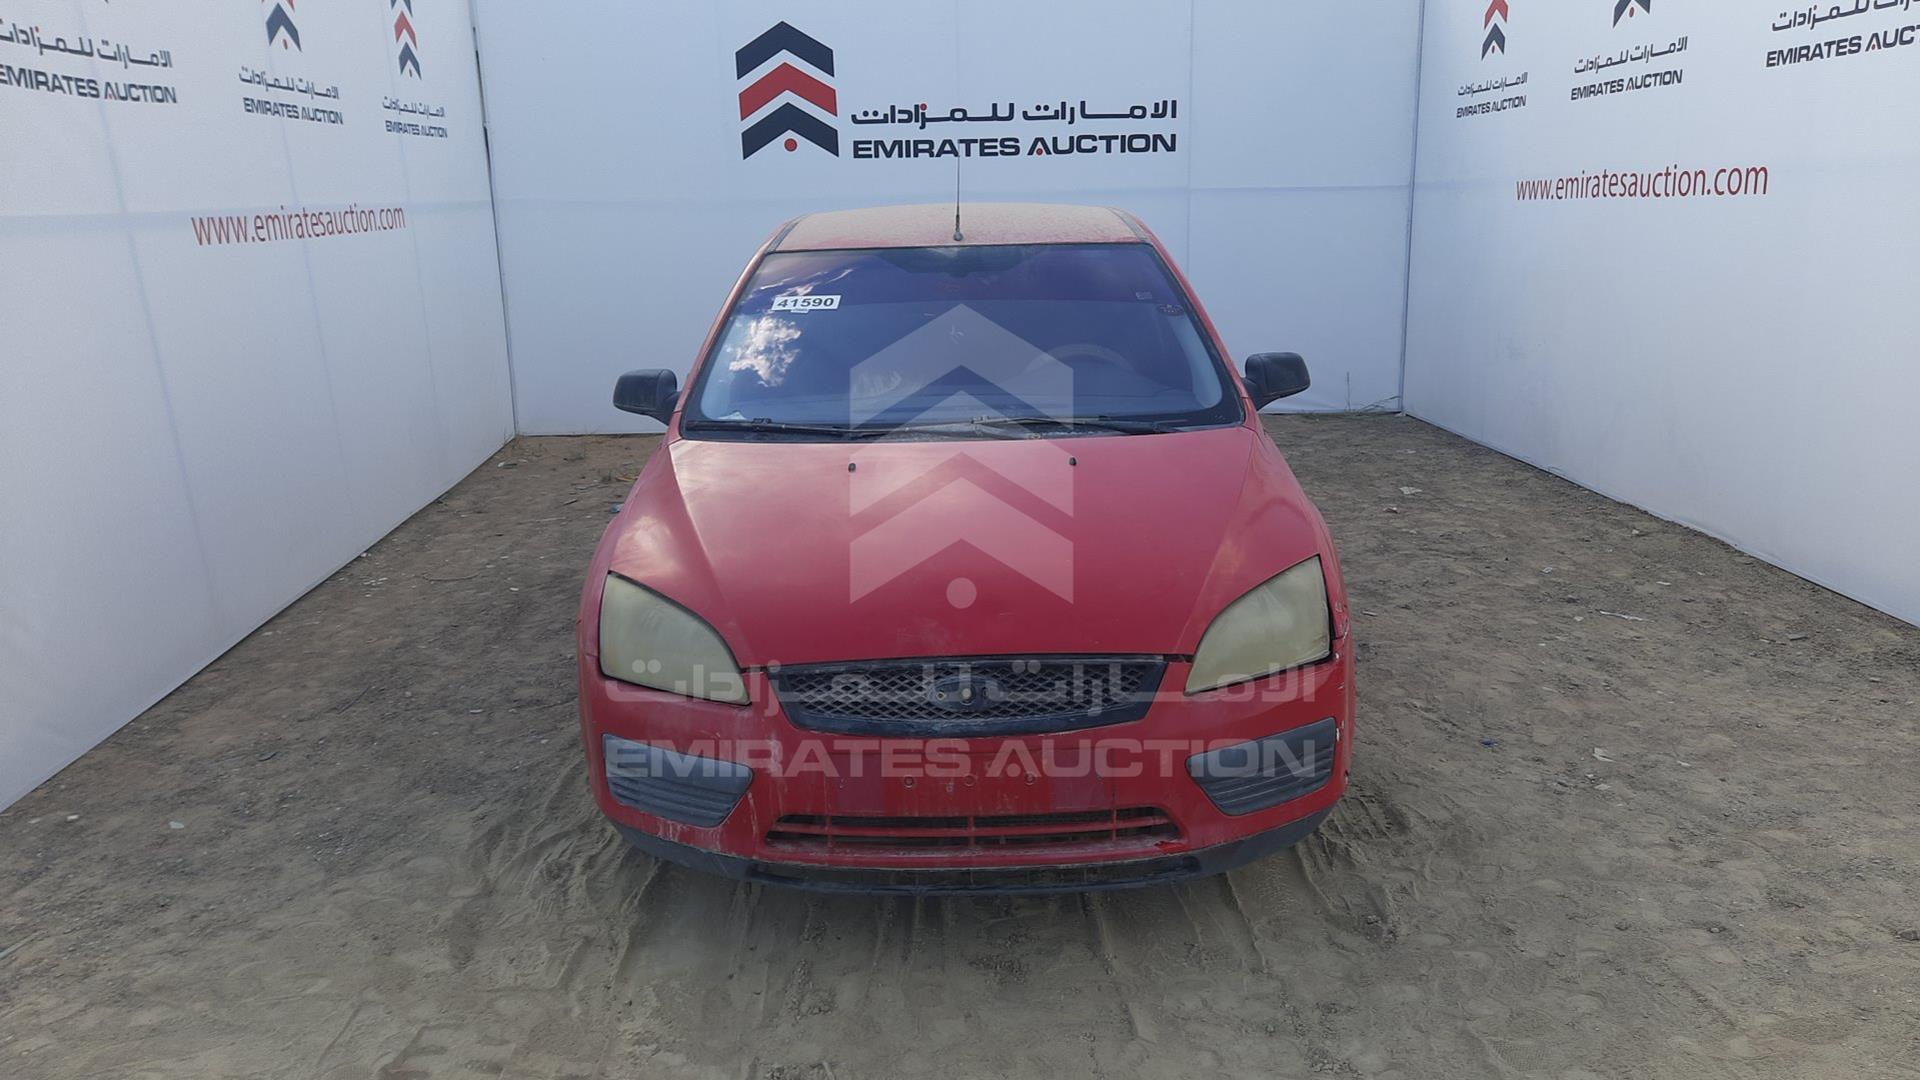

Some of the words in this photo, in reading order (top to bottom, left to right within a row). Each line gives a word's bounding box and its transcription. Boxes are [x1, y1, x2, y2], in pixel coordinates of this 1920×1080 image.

[1765, 35, 1862, 68] EMIRATES
[104, 81, 178, 104] AUCTION
[1570, 78, 1624, 101] EMIRATES
[1626, 69, 1683, 91] AUCTION
[242, 97, 300, 120] EMIRATES
[301, 106, 344, 125] AUCTION
[1456, 101, 1491, 118] EMIRATES
[1491, 94, 1527, 113] AUCTION
[385, 119, 420, 136] EMIRATES
[420, 124, 448, 138] AUCTION
[853, 136, 1021, 159] EMIRATES
[1027, 133, 1177, 156] AUCTION
[1516, 163, 1768, 201] www.emiratesauction.com
[191, 205, 406, 246] www.emiratesauction.com
[777, 297, 834, 308] 41590
